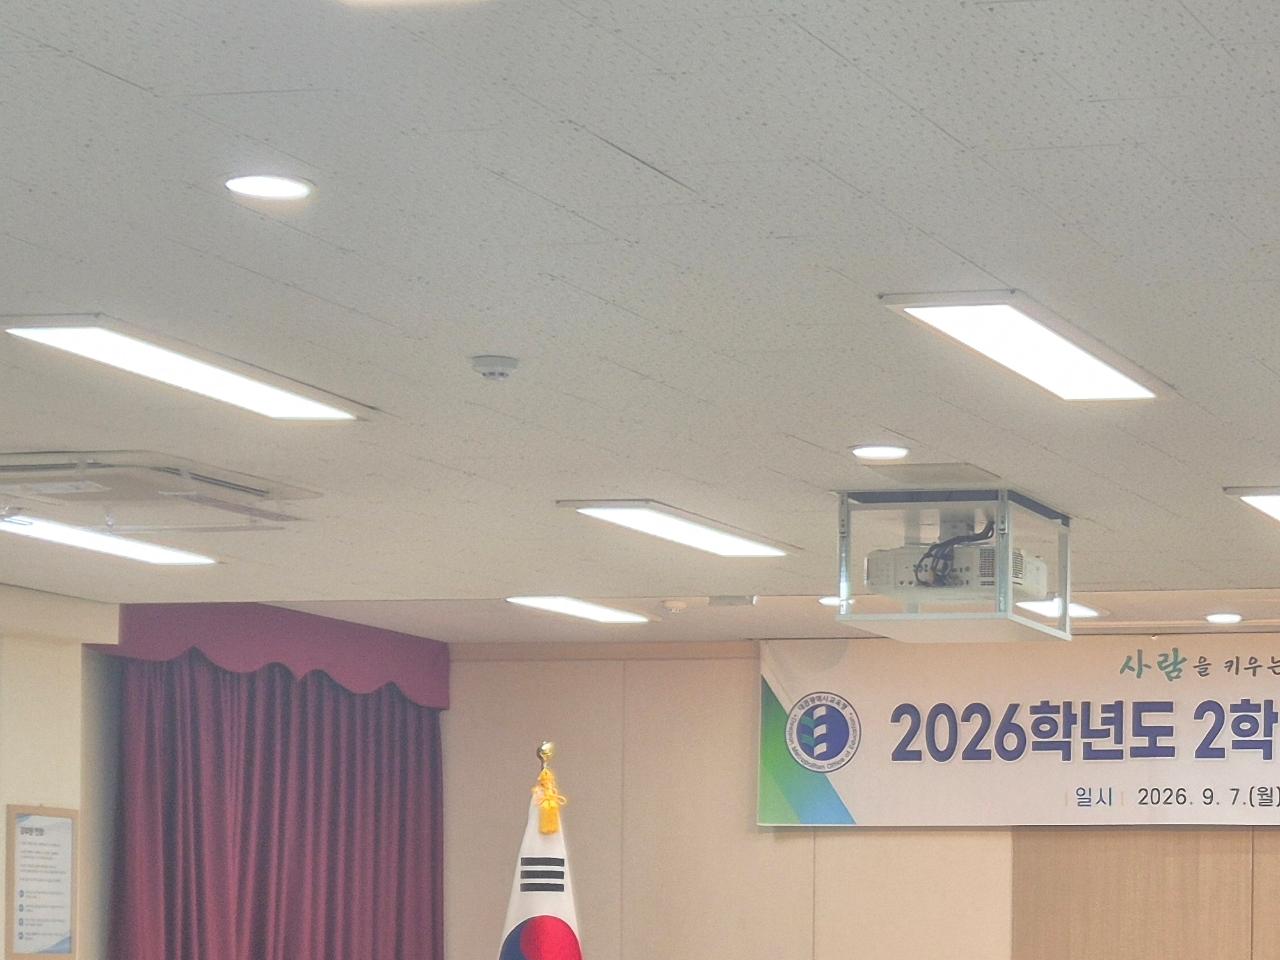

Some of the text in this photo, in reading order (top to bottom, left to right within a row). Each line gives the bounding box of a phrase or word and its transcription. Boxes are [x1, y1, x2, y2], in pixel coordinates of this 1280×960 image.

[1119, 647, 1212, 682] 사람을
[890, 700, 1176, 762] 2026학년도
[1075, 787, 1113, 806] 일시
[1137, 788, 1193, 805] 2026.
[1202, 788, 1220, 805] 9.
